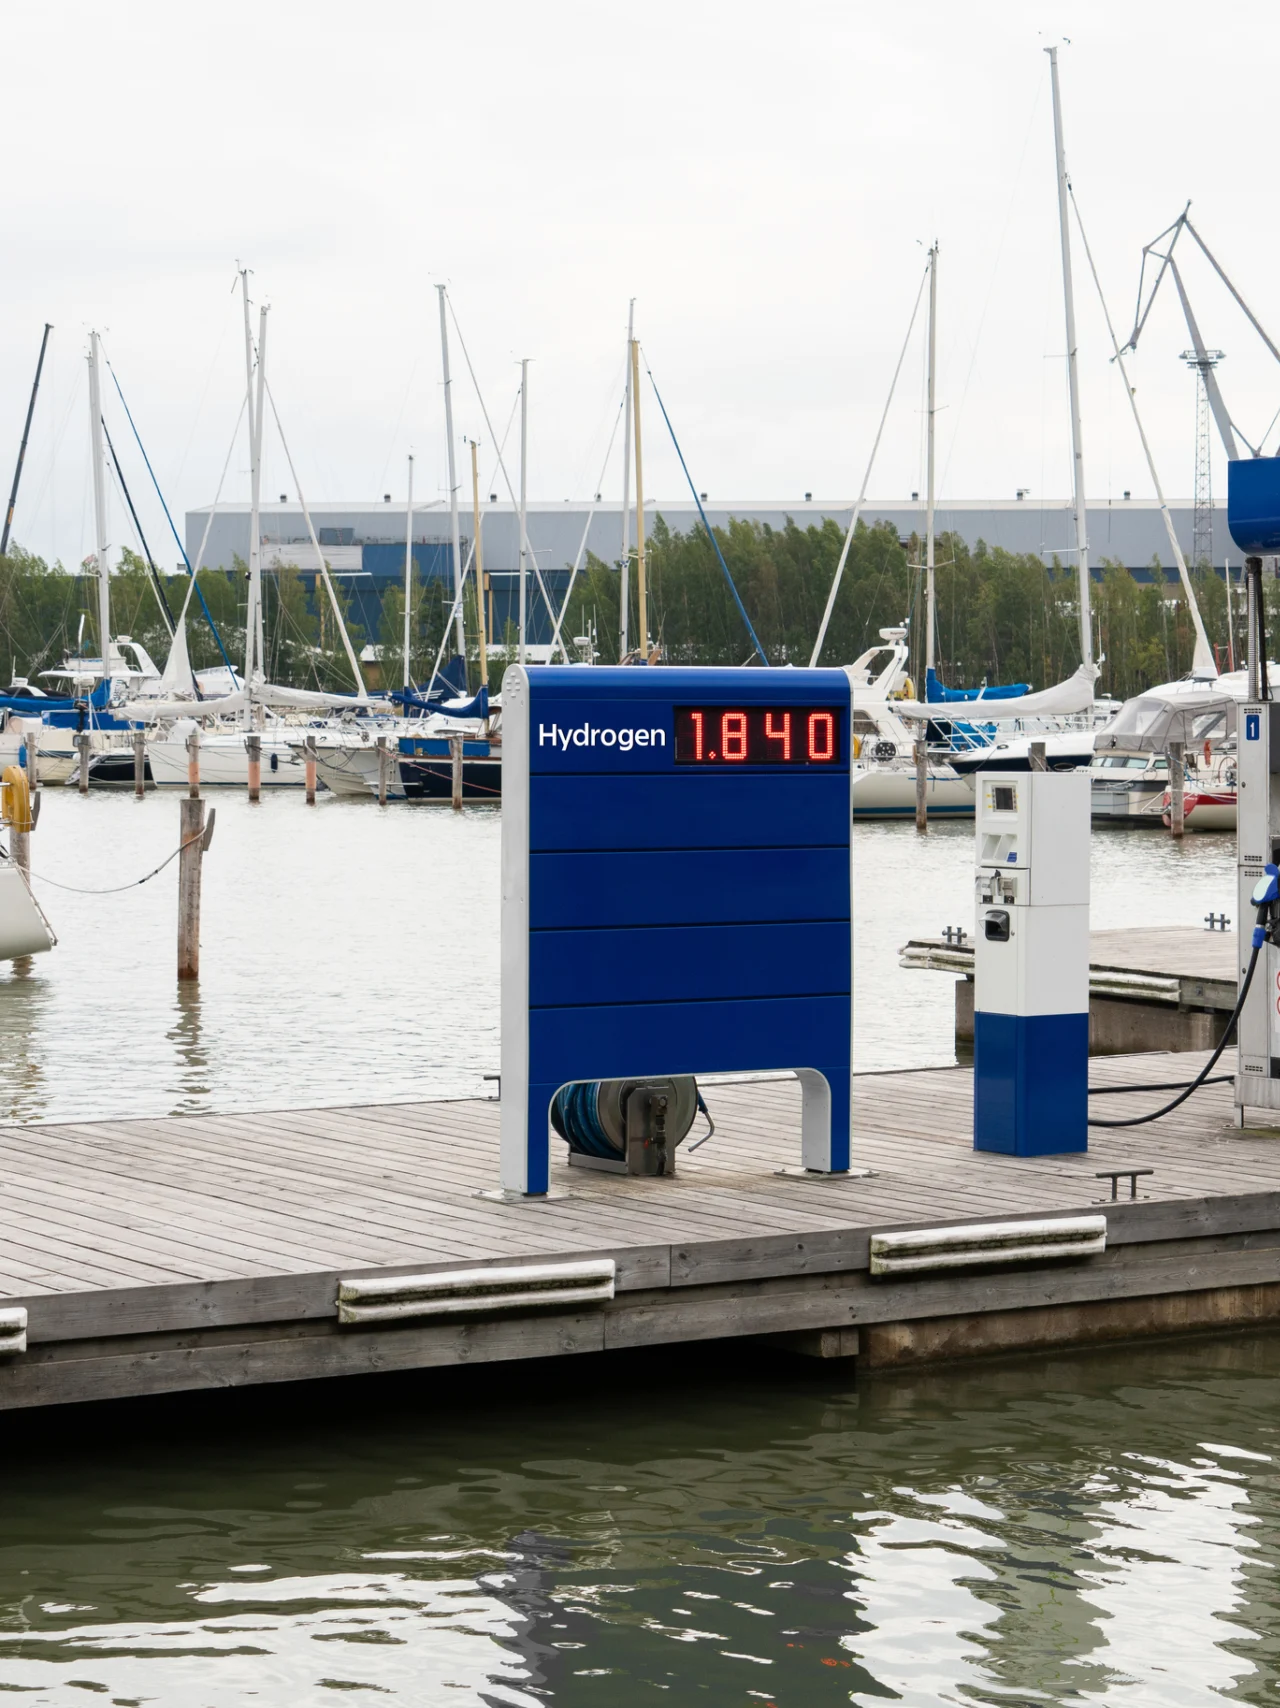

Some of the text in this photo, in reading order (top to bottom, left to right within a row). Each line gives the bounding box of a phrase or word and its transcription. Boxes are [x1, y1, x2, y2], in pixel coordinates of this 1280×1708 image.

[539, 722, 666, 752] Hydrogen
[691, 713, 833, 760] 1.840
[1250, 722, 1255, 738] 1
